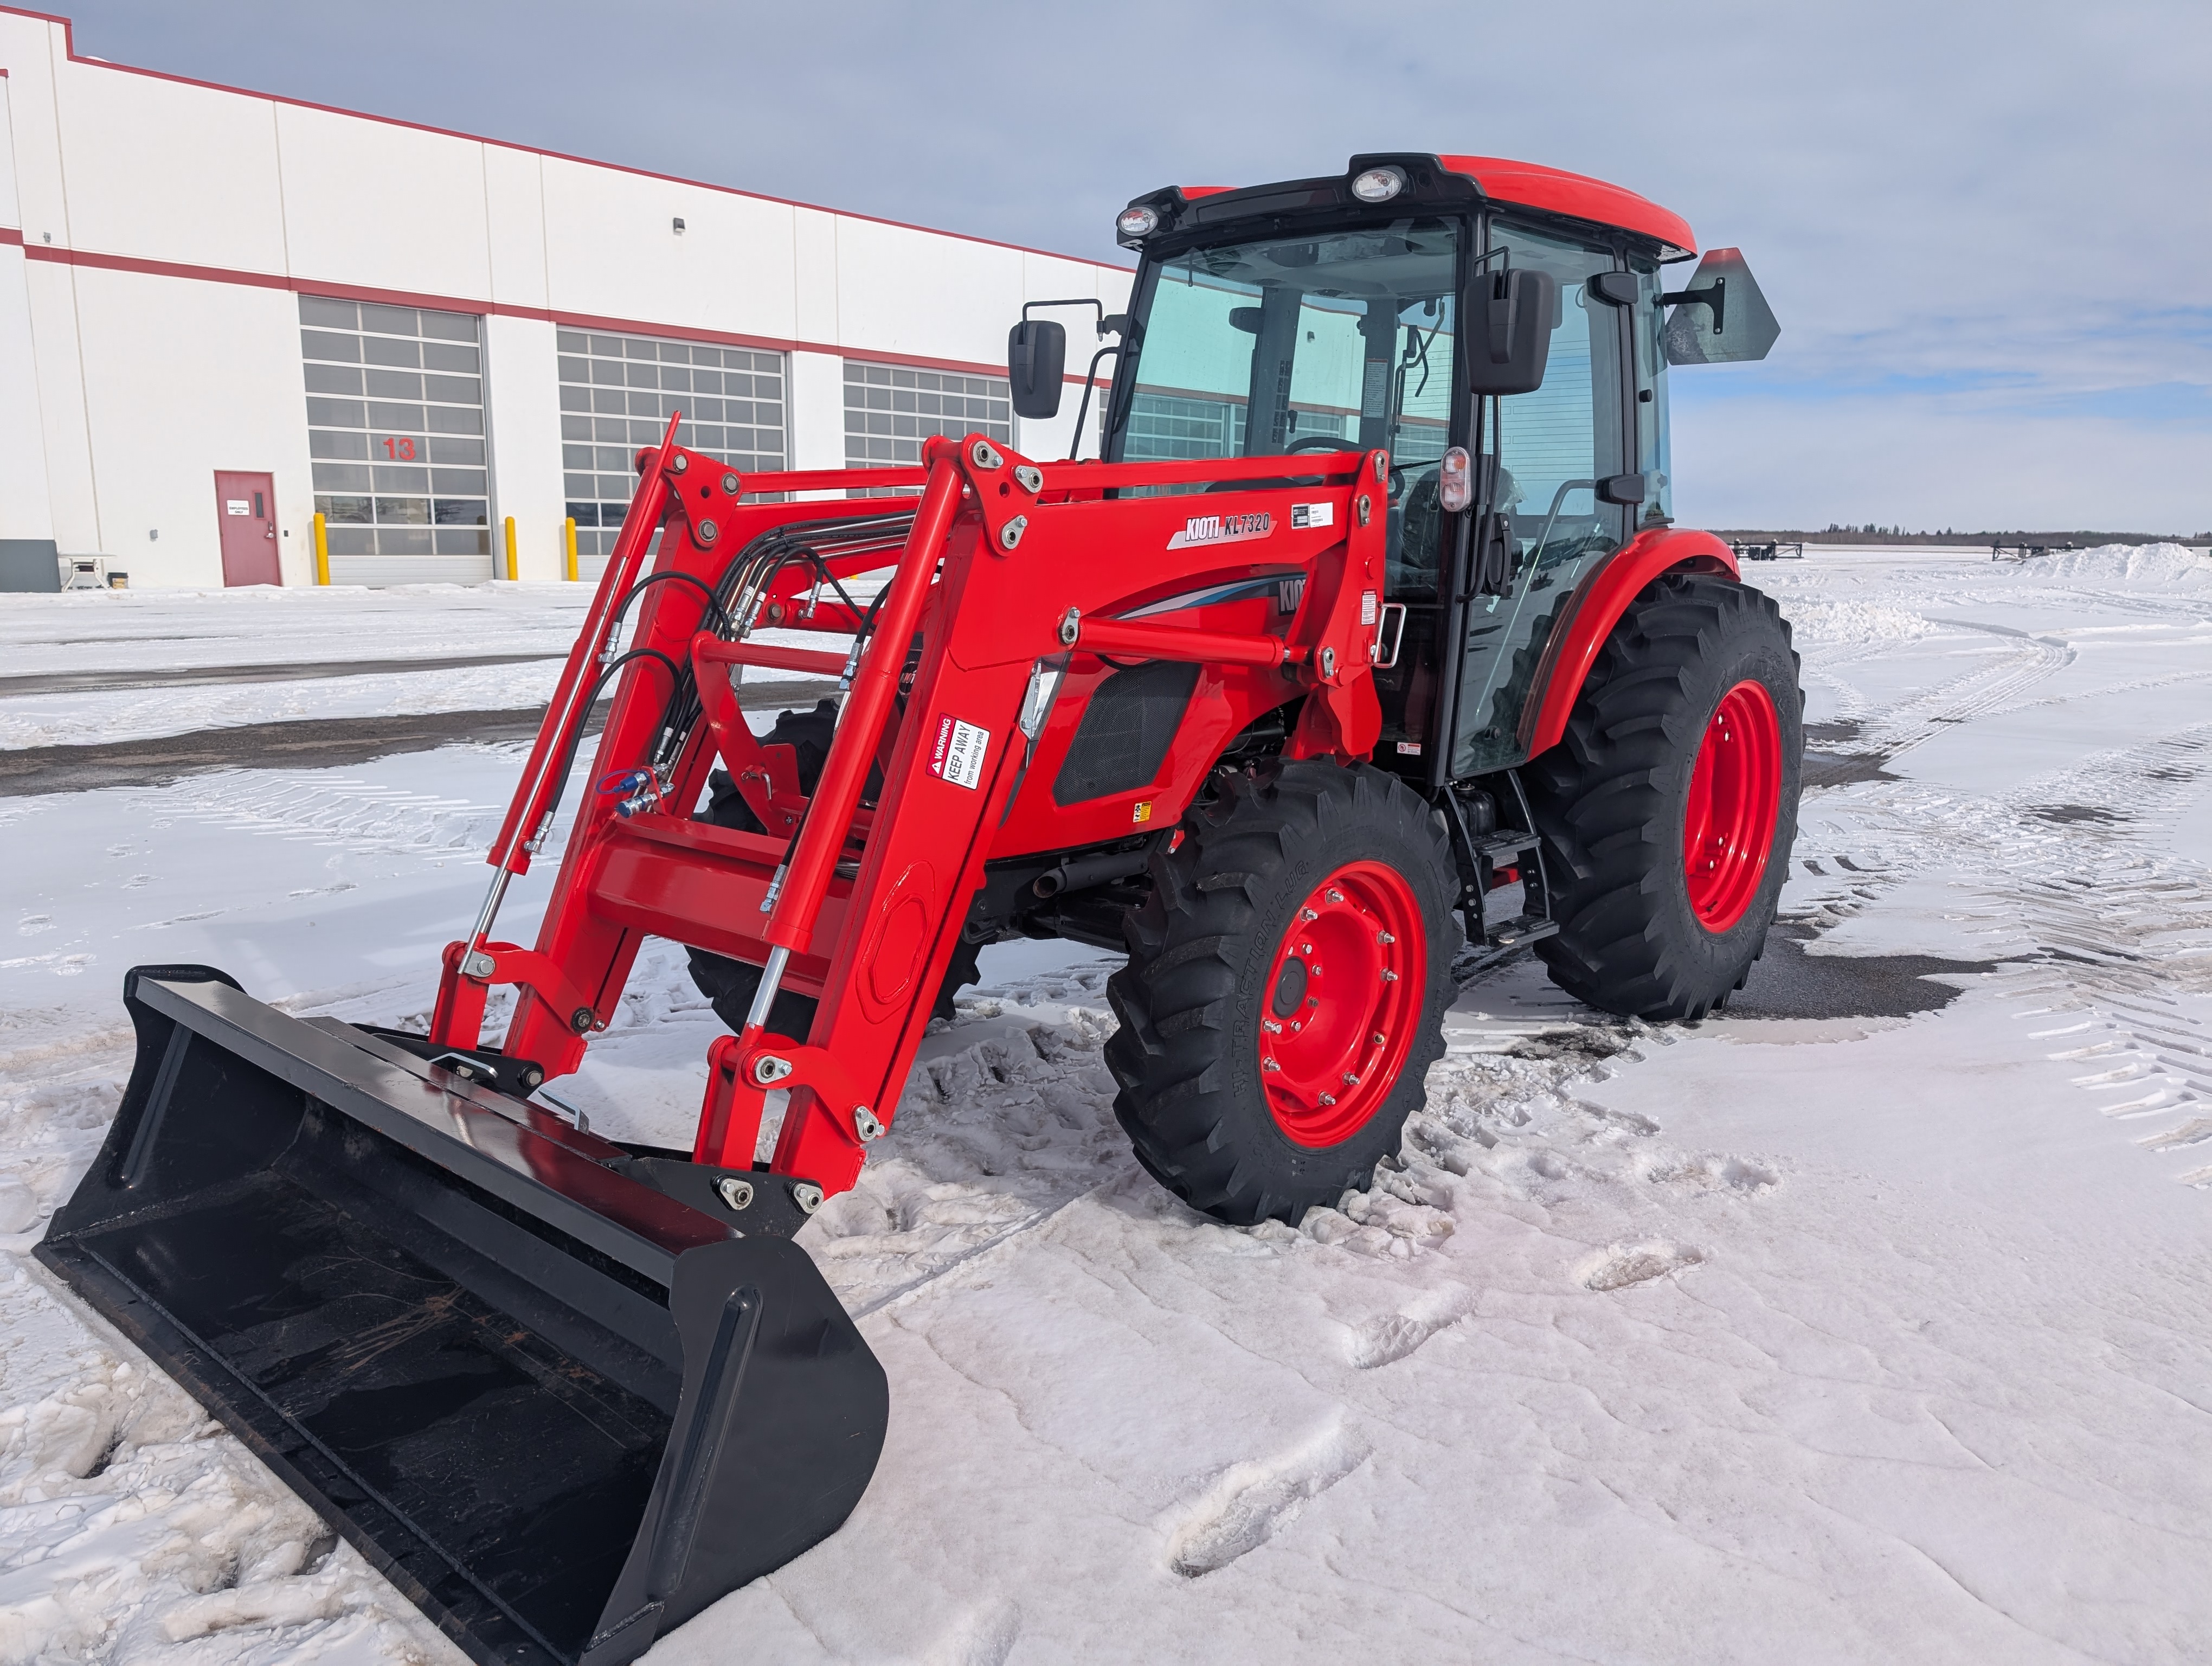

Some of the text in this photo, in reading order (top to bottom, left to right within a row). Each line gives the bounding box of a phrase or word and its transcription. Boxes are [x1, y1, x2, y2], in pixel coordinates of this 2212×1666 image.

[383, 437, 416, 460] 13
[1186, 516, 1220, 541] KIOTI
[1224, 512, 1270, 536] KL7320
[1279, 579, 1306, 612] KIO
[934, 718, 951, 759] WARNING
[948, 725, 970, 780] KEEP AWAY
[963, 731, 984, 785] from working area
[1275, 860, 1309, 909] LUG
